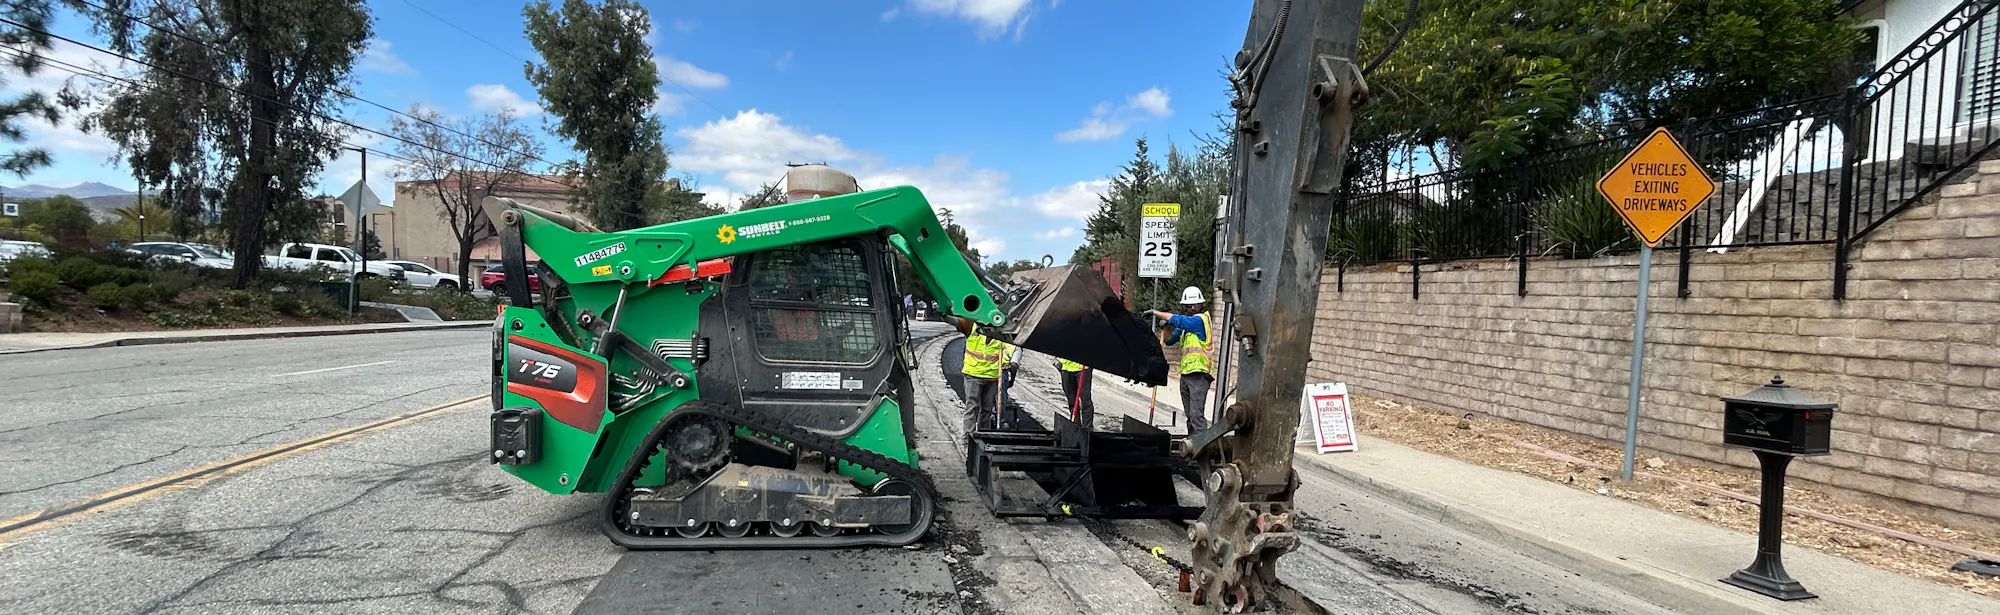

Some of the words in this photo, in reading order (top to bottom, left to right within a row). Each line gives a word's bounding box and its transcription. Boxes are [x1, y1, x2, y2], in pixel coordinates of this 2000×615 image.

[1630, 163, 1687, 177] VEHICLES
[1634, 180, 1679, 194] EXITING
[1145, 207, 1177, 215] SCHOOL
[1623, 198, 1687, 211] DRIVEWAYS
[738, 220, 786, 236] SUNBELT
[746, 230, 780, 239] RENTALS
[576, 242, 626, 266] 11484779
[1144, 242, 1172, 257] 25
[519, 359, 561, 379] T76
